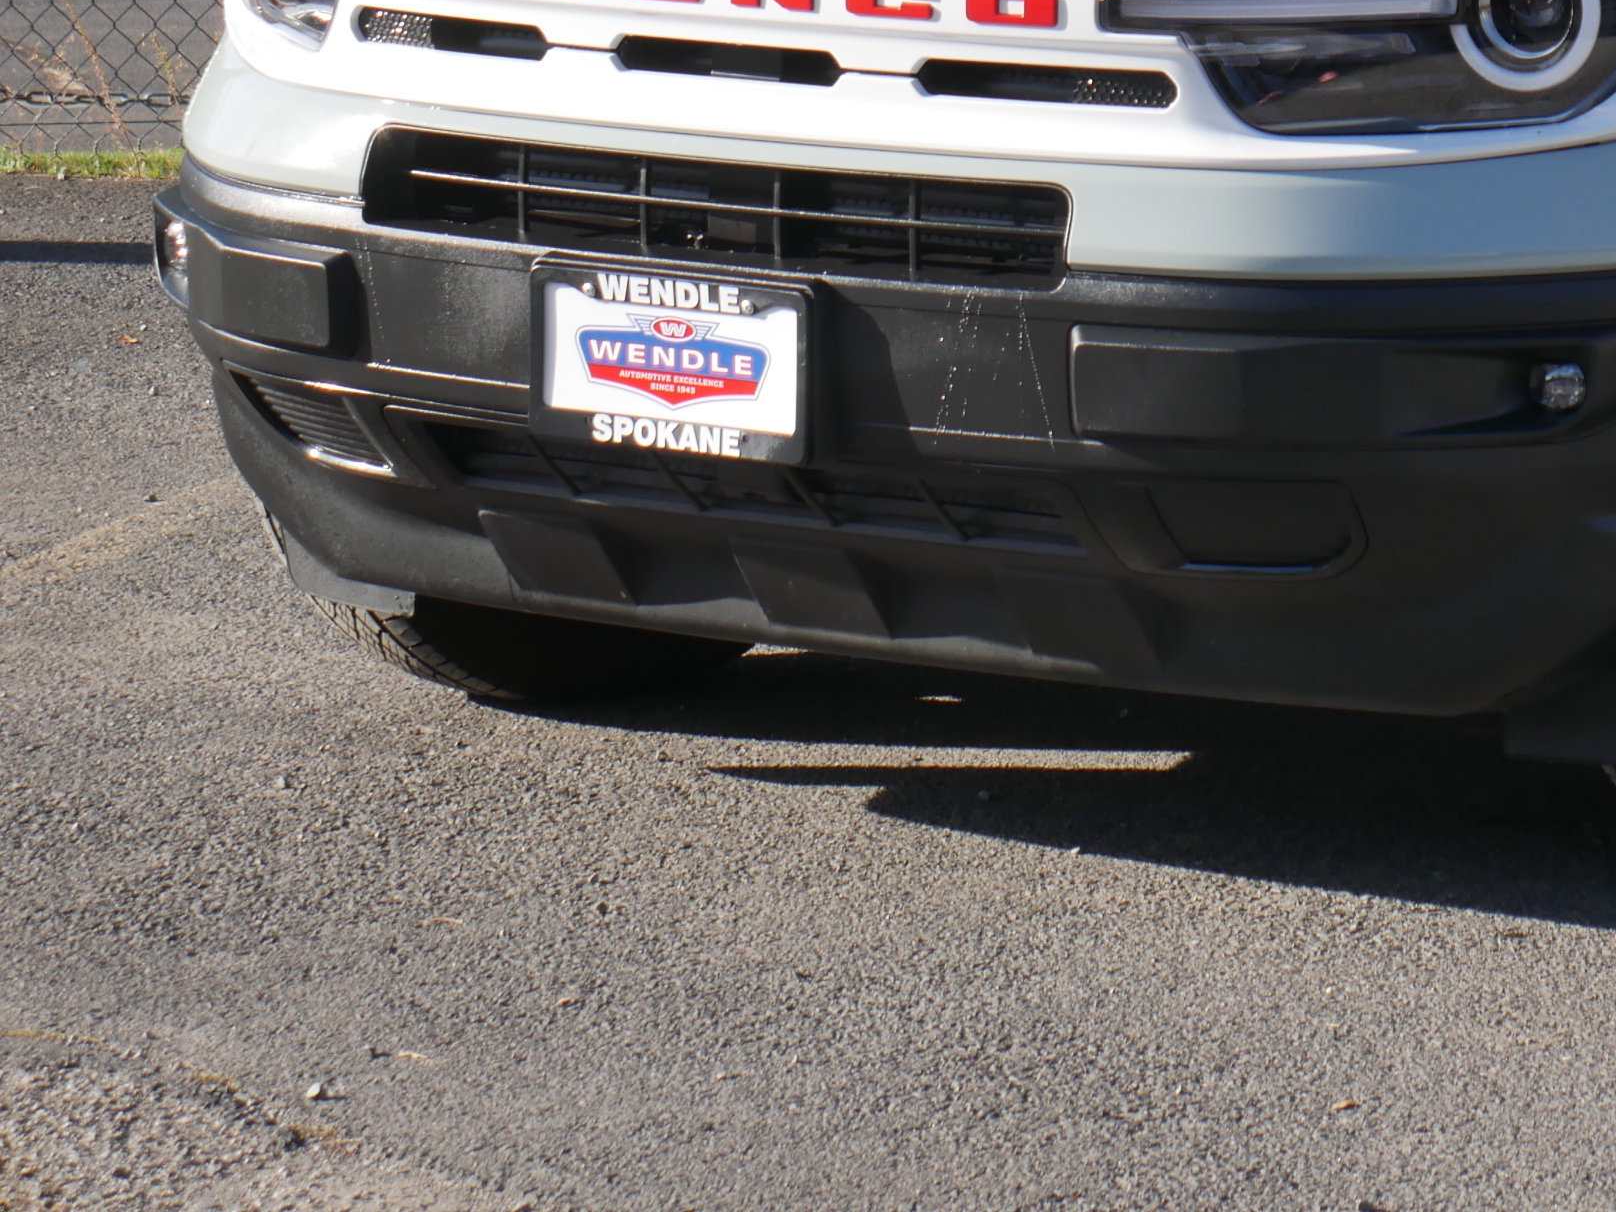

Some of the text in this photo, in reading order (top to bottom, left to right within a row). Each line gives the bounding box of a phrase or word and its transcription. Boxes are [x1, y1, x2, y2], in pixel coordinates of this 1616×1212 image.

[597, 273, 740, 314] WENDLE
[659, 322, 687, 337] W
[589, 339, 752, 376] WENDLE
[619, 370, 724, 388] AUTOMOTIVE EXCELLENCE
[650, 382, 675, 392] SINCE
[593, 414, 741, 457] SPOKANE
